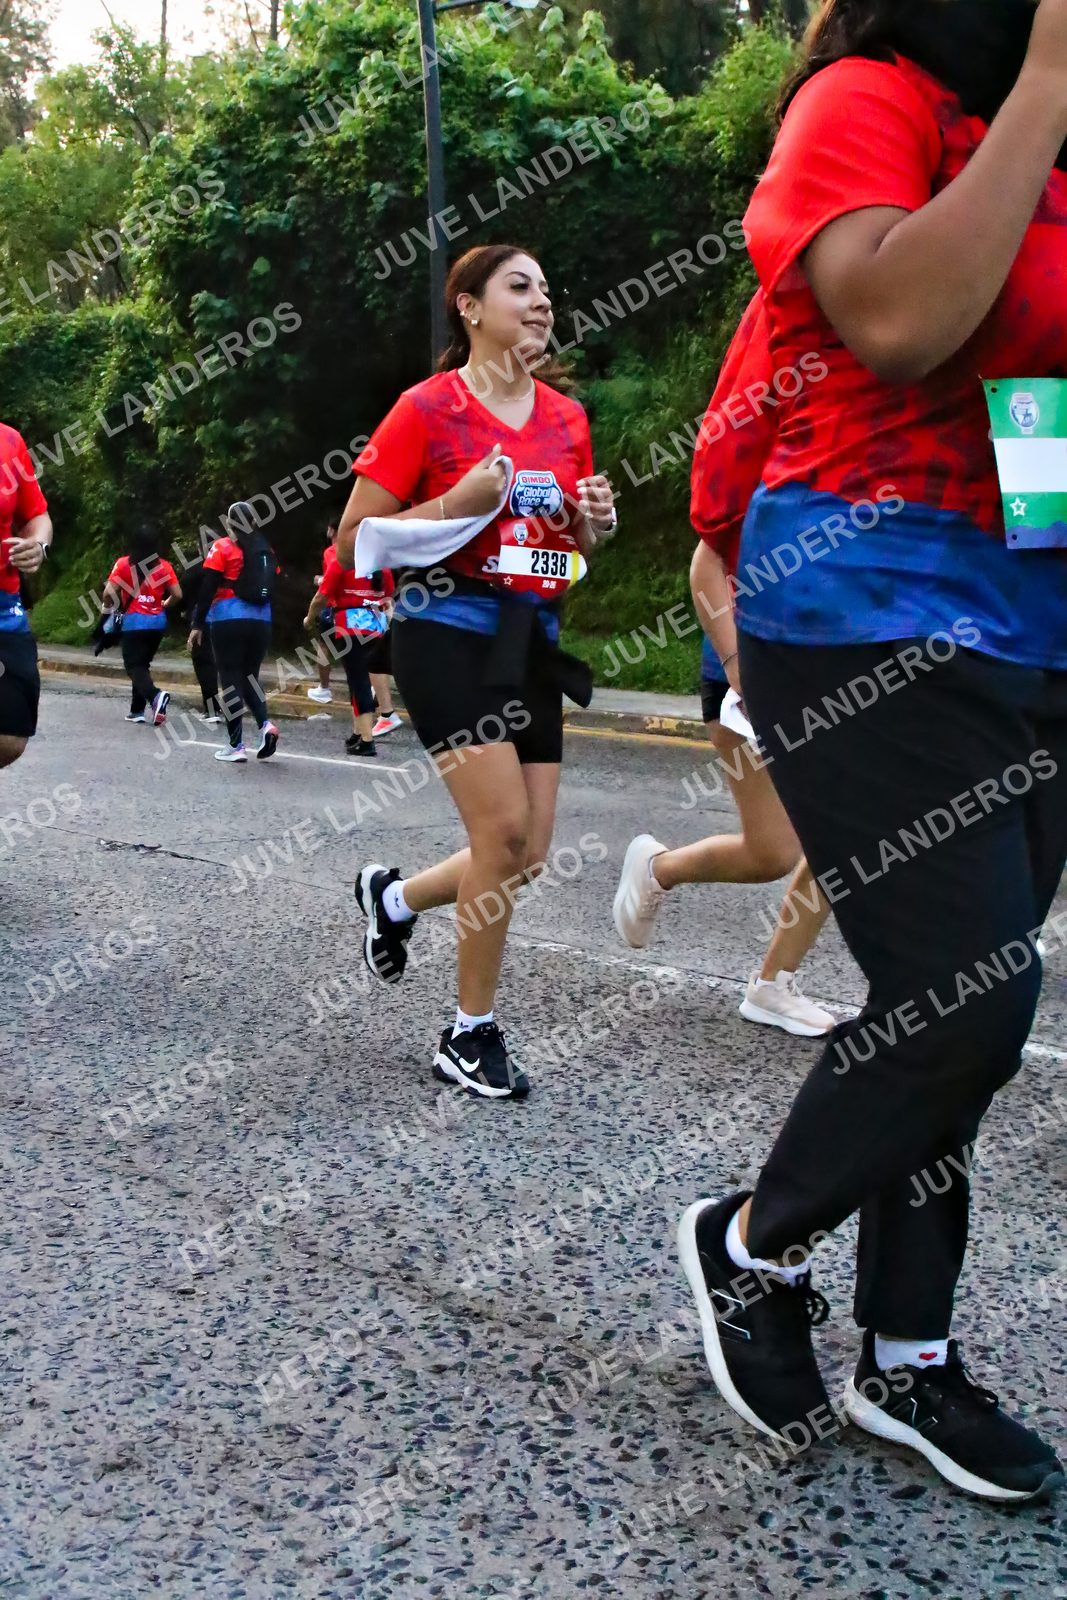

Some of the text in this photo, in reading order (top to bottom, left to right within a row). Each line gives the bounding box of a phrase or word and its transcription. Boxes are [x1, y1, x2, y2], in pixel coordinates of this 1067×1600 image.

[521, 476, 551, 484] BIMBO
[523, 486, 552, 498] Global
[518, 496, 541, 506] Race
[531, 550, 568, 577] 2338
